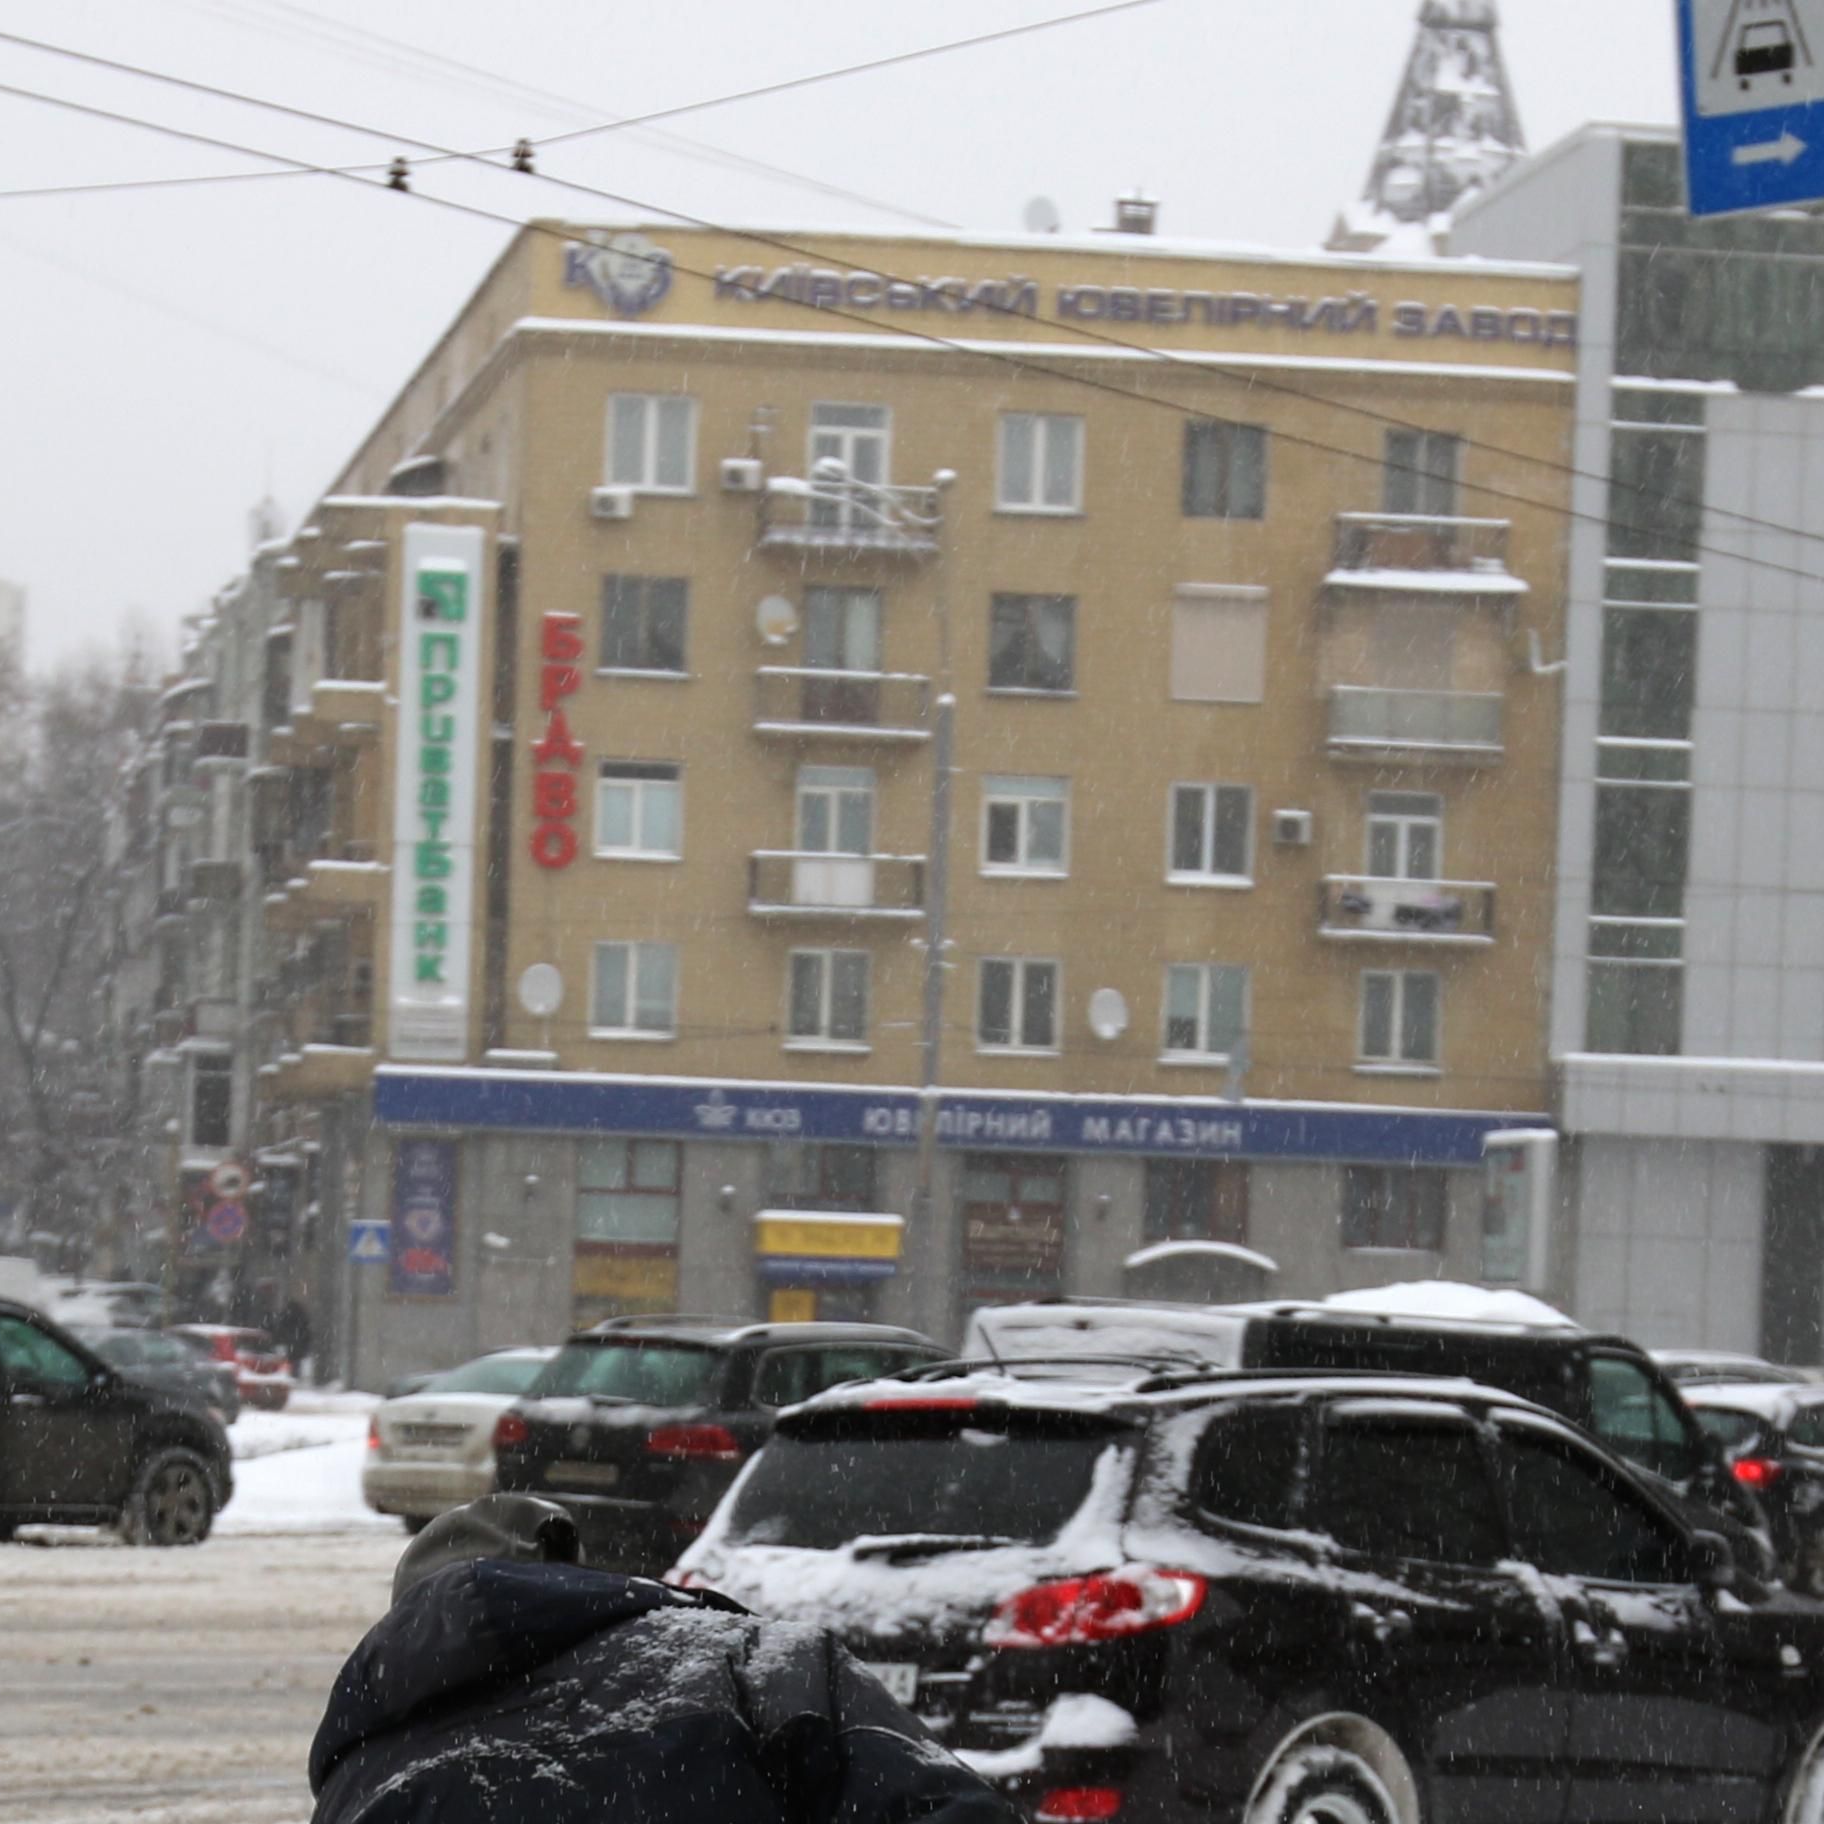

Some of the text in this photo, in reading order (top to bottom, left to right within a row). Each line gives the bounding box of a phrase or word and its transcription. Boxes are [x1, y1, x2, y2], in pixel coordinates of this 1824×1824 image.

[714, 262, 1039, 321] КИЇВСЬКИЙ
[1056, 284, 1378, 338] ЮВЕЛІРНИЙ
[1391, 300, 1576, 350] ЗАВОД
[529, 614, 585, 870] БРАВО
[862, 1105, 1053, 1140] ЮВЛІРНИЙ
[1081, 1115, 1243, 1147] МАГАЗИН
